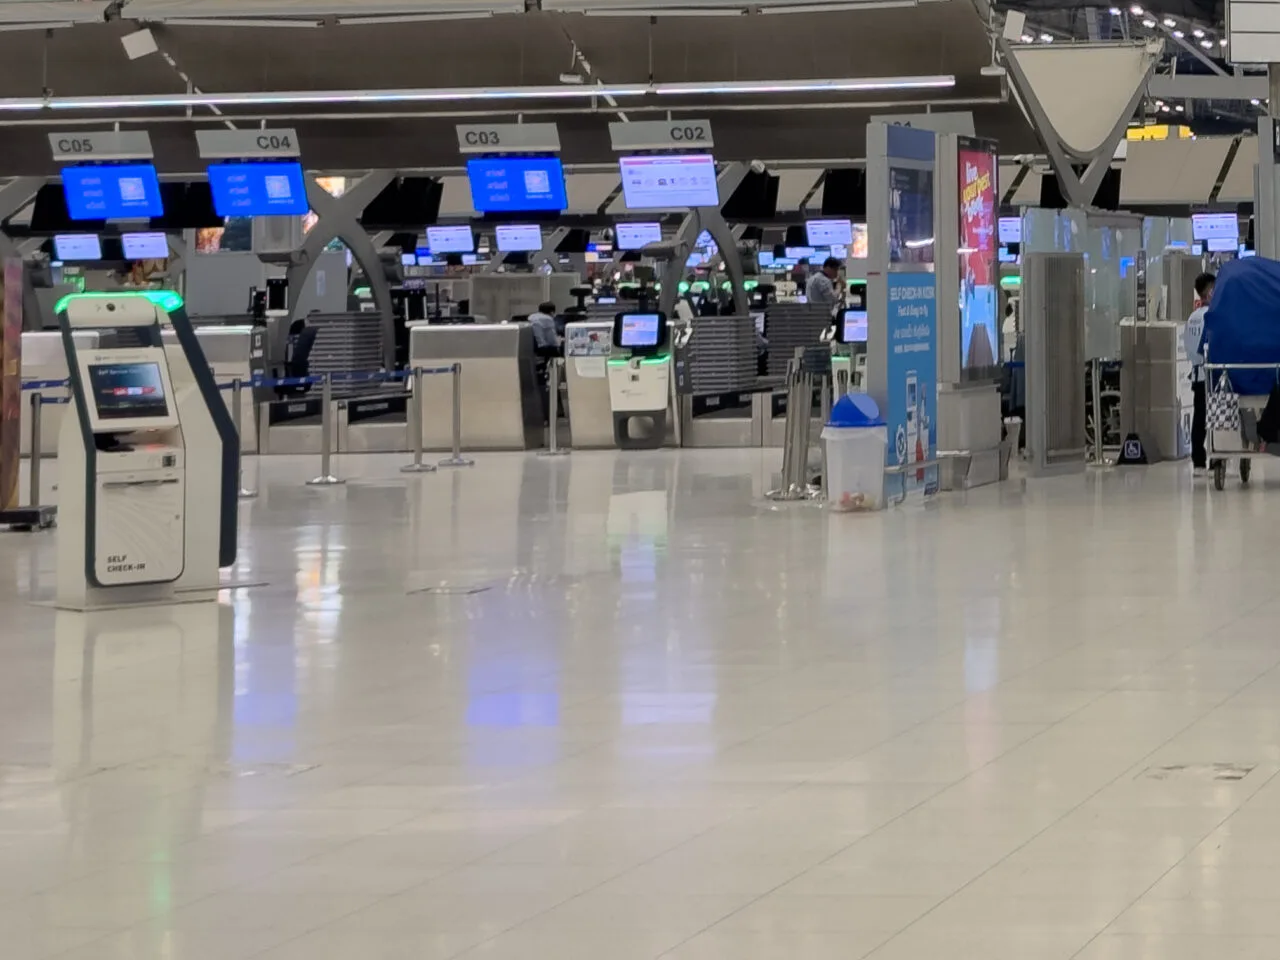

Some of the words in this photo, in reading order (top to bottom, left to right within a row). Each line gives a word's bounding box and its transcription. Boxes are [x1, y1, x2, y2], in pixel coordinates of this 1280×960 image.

[465, 131, 500, 145] C03
[670, 127, 705, 141] C02
[58, 139, 93, 153] C05
[256, 135, 291, 149] C04
[107, 554, 127, 563] SELF
[107, 563, 146, 572] CHECK-IN
